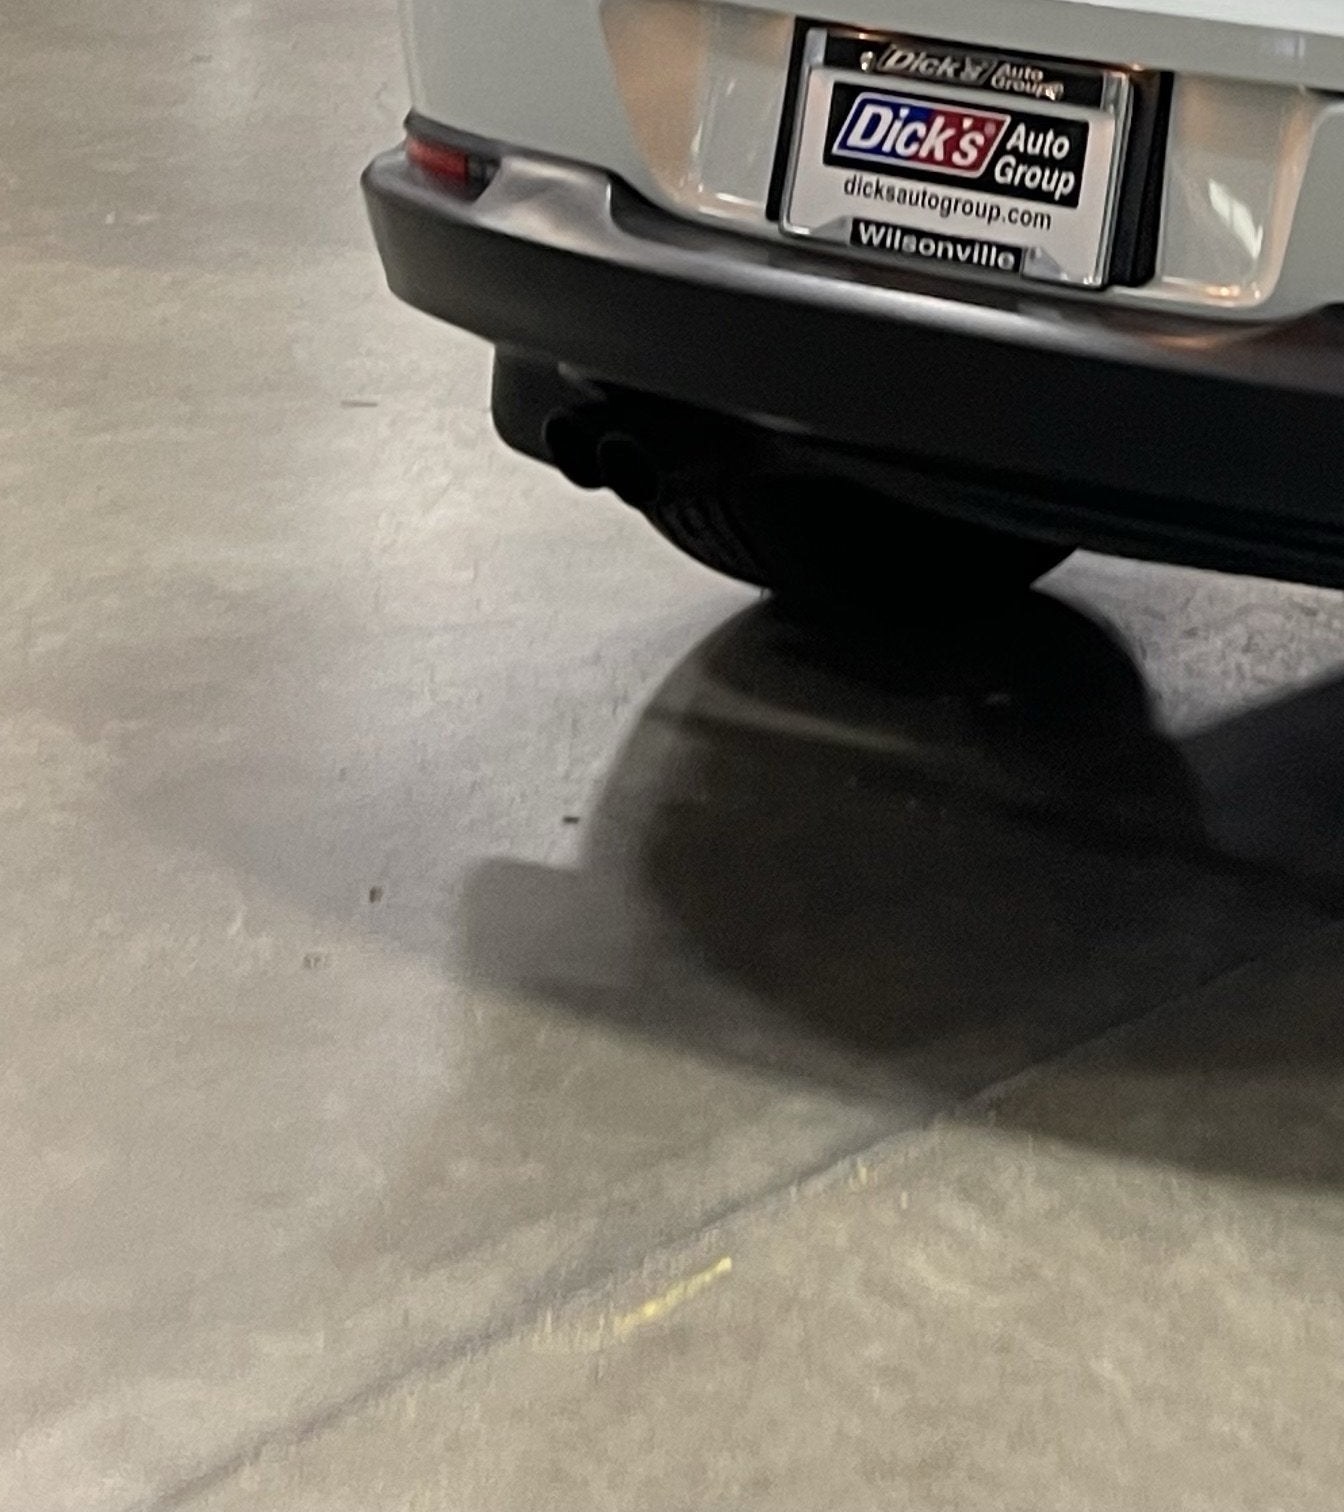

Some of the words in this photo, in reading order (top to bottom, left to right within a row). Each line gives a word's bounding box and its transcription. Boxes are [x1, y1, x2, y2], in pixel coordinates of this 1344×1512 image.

[846, 103, 985, 167] Dick's
[1005, 122, 1070, 161] Auto
[843, 174, 1053, 231] dicksautogroup.com
[994, 154, 1076, 202] Group
[858, 221, 1016, 271] Wilsonville
